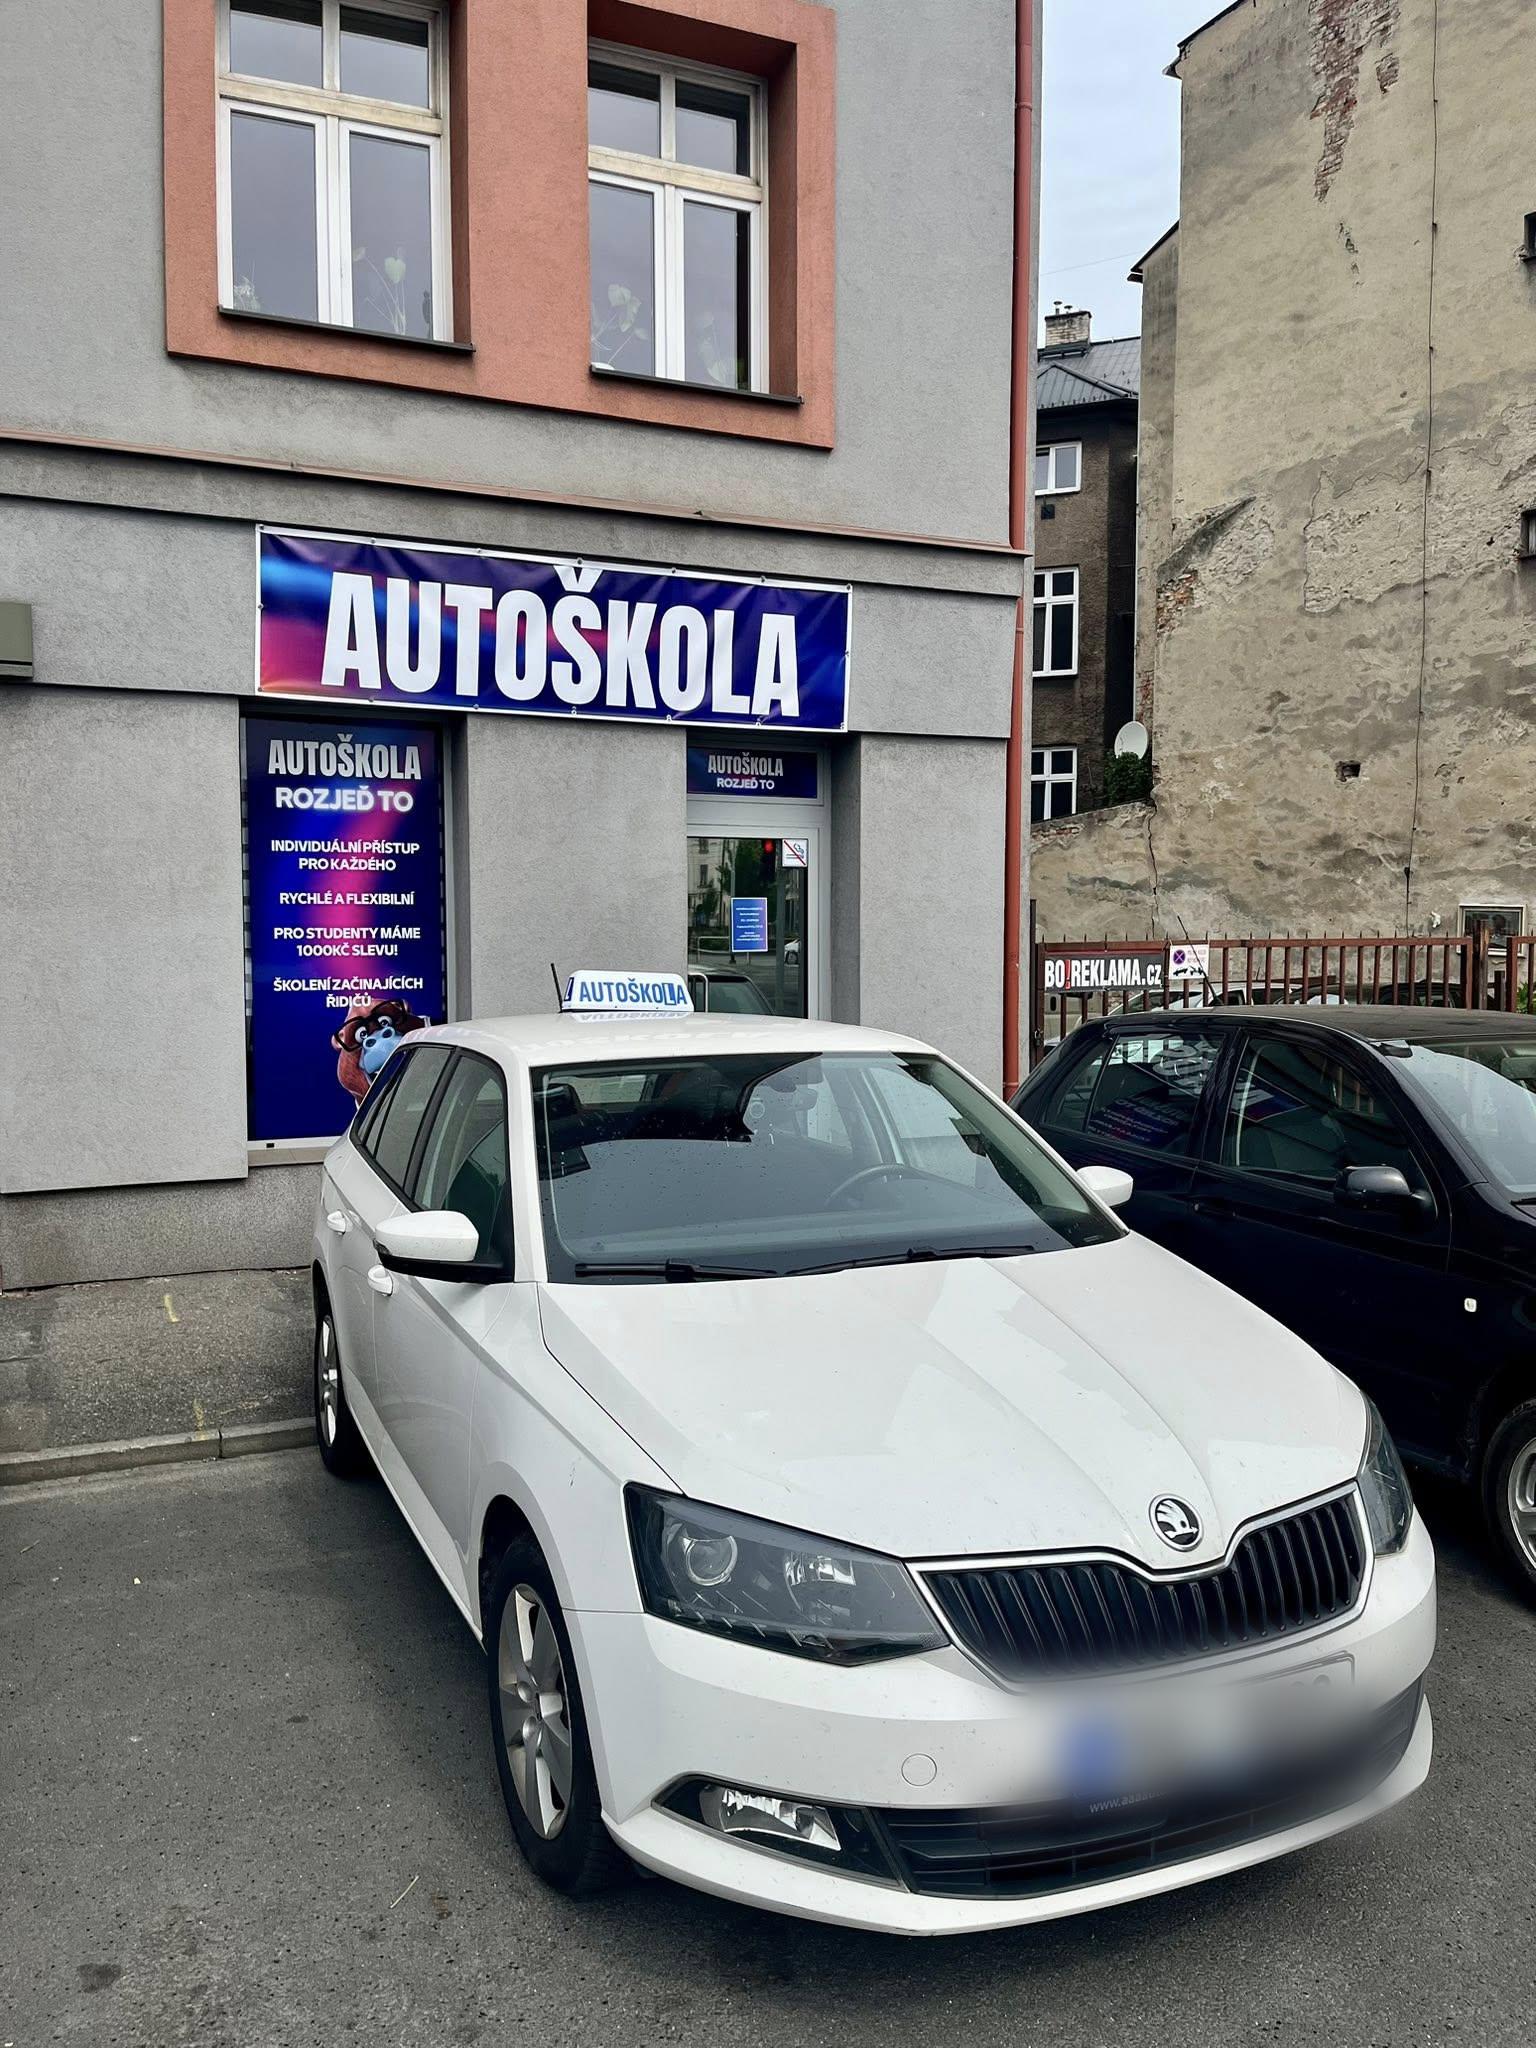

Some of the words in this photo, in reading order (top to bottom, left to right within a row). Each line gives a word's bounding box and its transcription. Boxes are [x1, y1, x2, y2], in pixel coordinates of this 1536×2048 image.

[321, 565, 800, 717] AUTOŠKOLA
[268, 733, 422, 780] AUTOŠKOLA
[708, 752, 784, 777] AUTOŠKOLA
[717, 777, 759, 789] ROZJEĎ
[760, 780, 775, 790] TO
[275, 785, 375, 811] ROZJEĎ
[377, 790, 414, 812] TO
[271, 838, 362, 853] INDIVIDUÁLNÍ
[363, 840, 420, 854] PŘÍSTUP
[299, 857, 329, 870] PRO
[330, 856, 397, 871] KAŽDÉHO
[279, 890, 333, 905] RYCHLÉ
[334, 893, 345, 905] A
[346, 891, 415, 905] FLEXIBILNÍ
[273, 927, 304, 939] PRO
[306, 927, 379, 939] STUDENTY
[380, 925, 421, 939] MÁME
[296, 942, 350, 957] 1000KČ
[352, 944, 398, 956] SLEVU!
[273, 976, 332, 991] ŠKOLENÍ
[332, 975, 424, 991] ZAČINAJÍCÍCH
[580, 977, 688, 1006] AUTOŠKOLA
[326, 992, 372, 1008] ŘIDIČŮ
